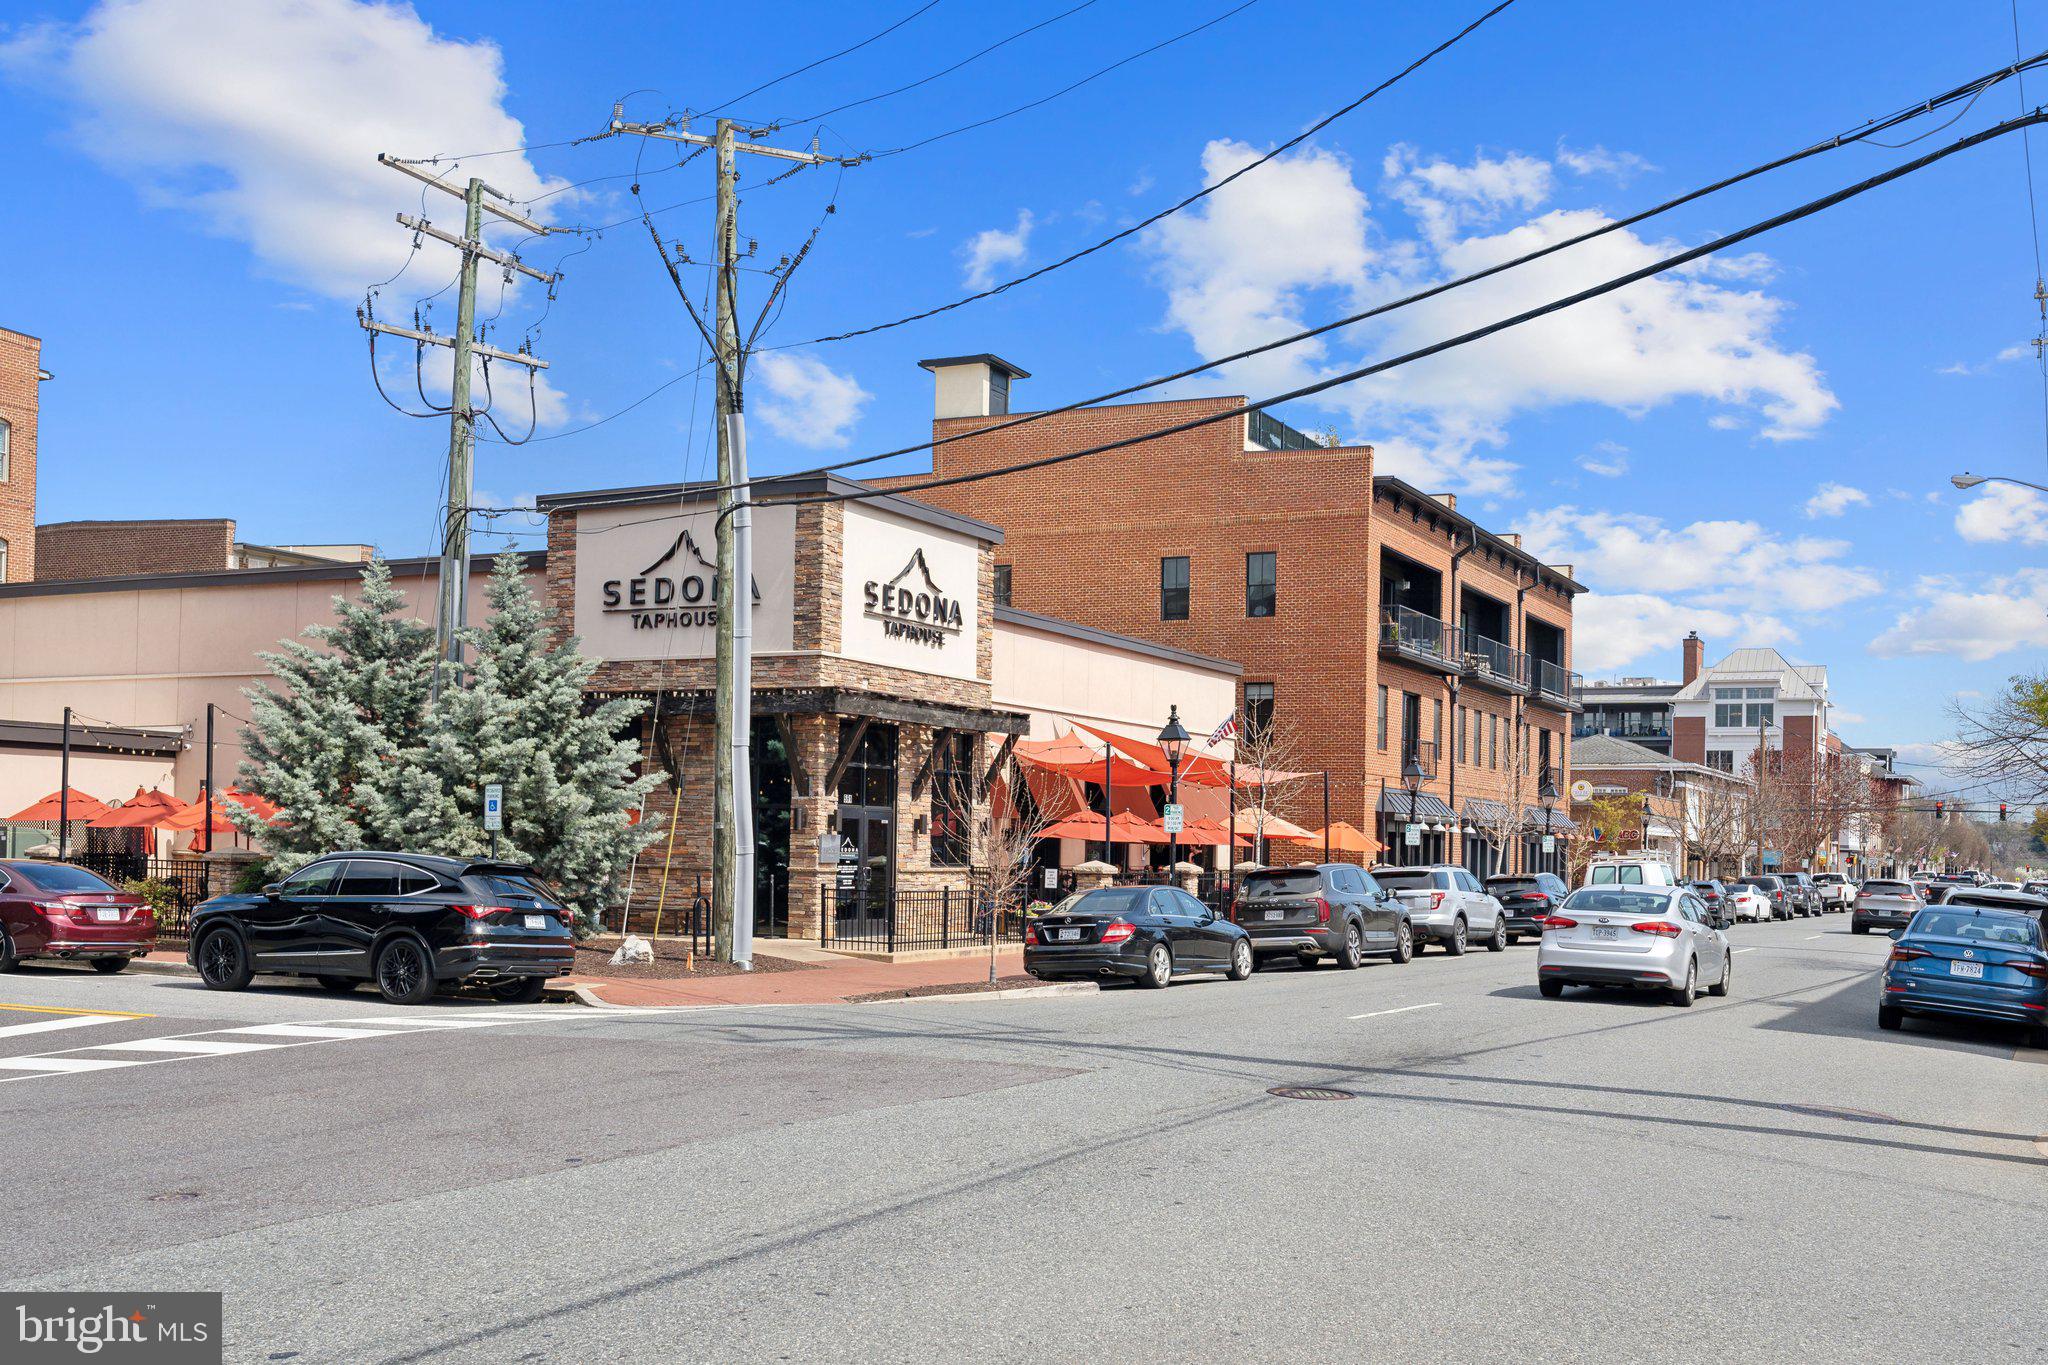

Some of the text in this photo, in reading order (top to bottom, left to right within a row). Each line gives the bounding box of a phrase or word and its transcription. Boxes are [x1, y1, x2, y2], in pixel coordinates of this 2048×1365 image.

[864, 580, 963, 626] SEDONA
[631, 611, 717, 629] TAPHOUS
[883, 620, 945, 646] TAPHOUSE
